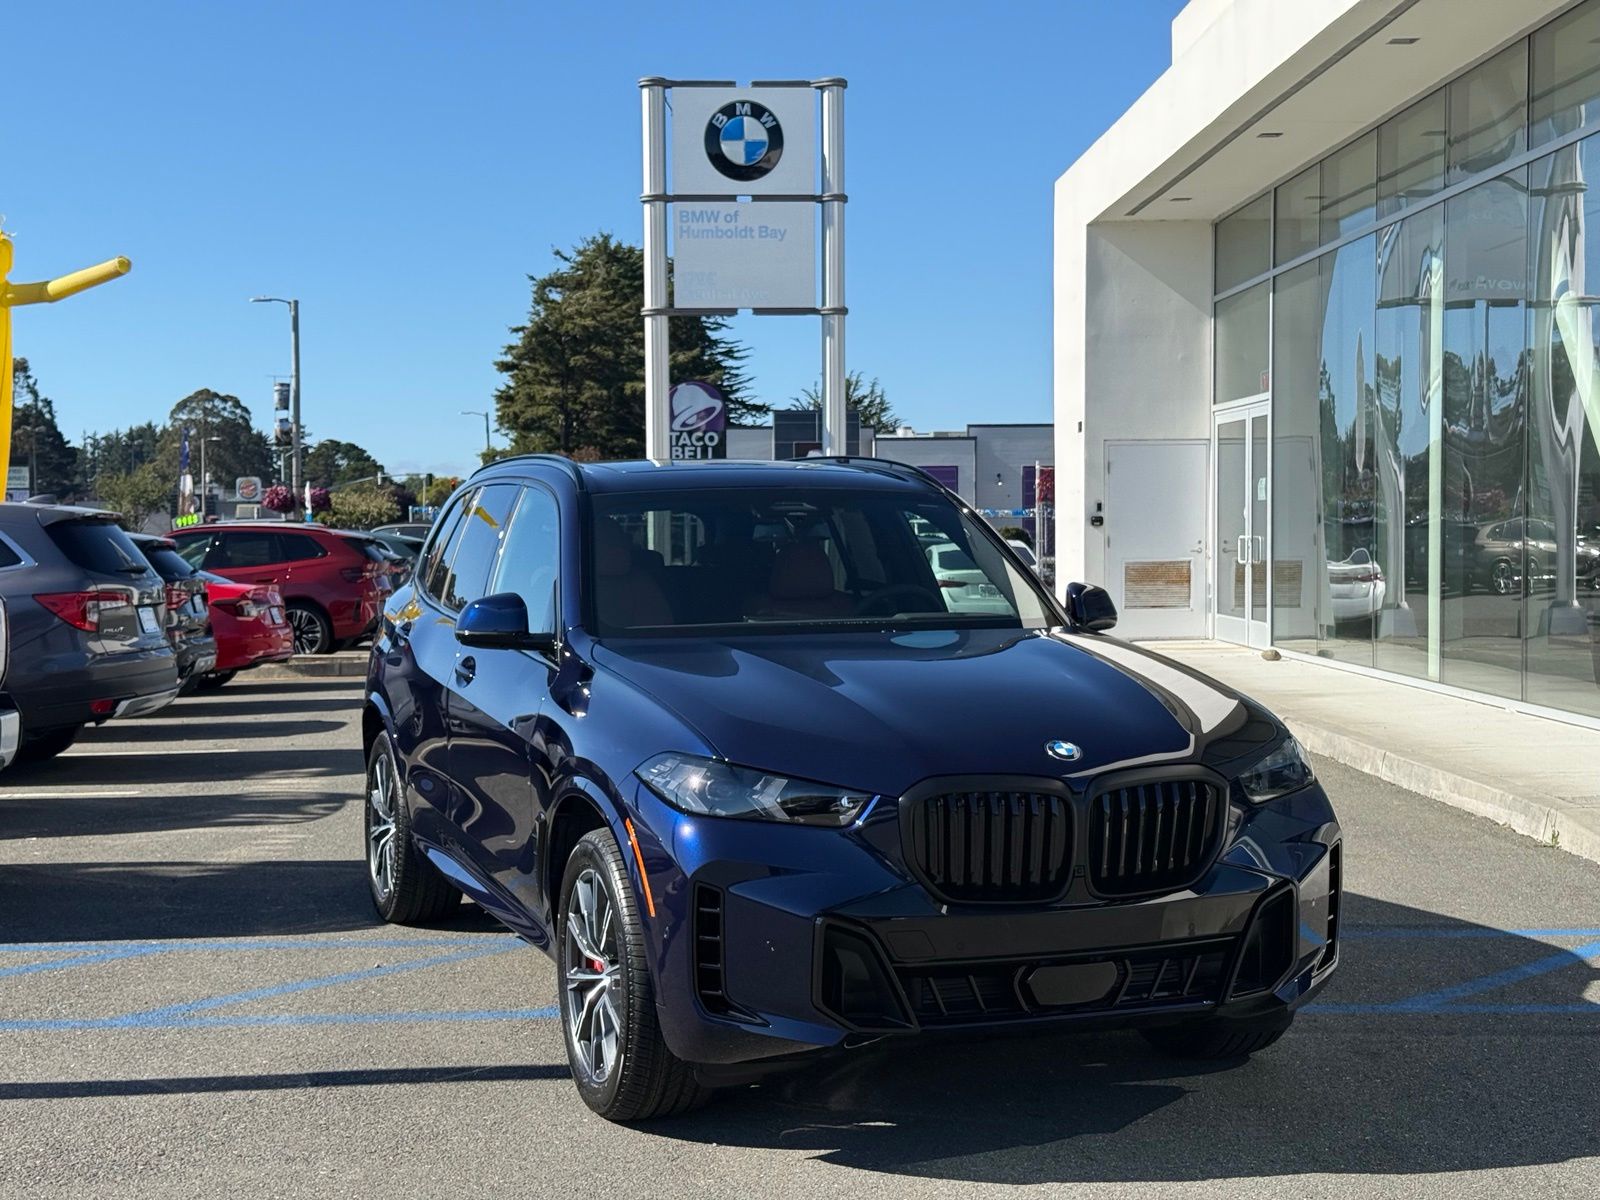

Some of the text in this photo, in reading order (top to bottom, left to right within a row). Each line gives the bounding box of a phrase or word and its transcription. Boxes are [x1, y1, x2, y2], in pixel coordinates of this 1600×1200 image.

[712, 102, 777, 130] BMW
[679, 210, 740, 224] BMW of
[679, 225, 787, 242] Humboldt Bay
[669, 431, 719, 447] TACO
